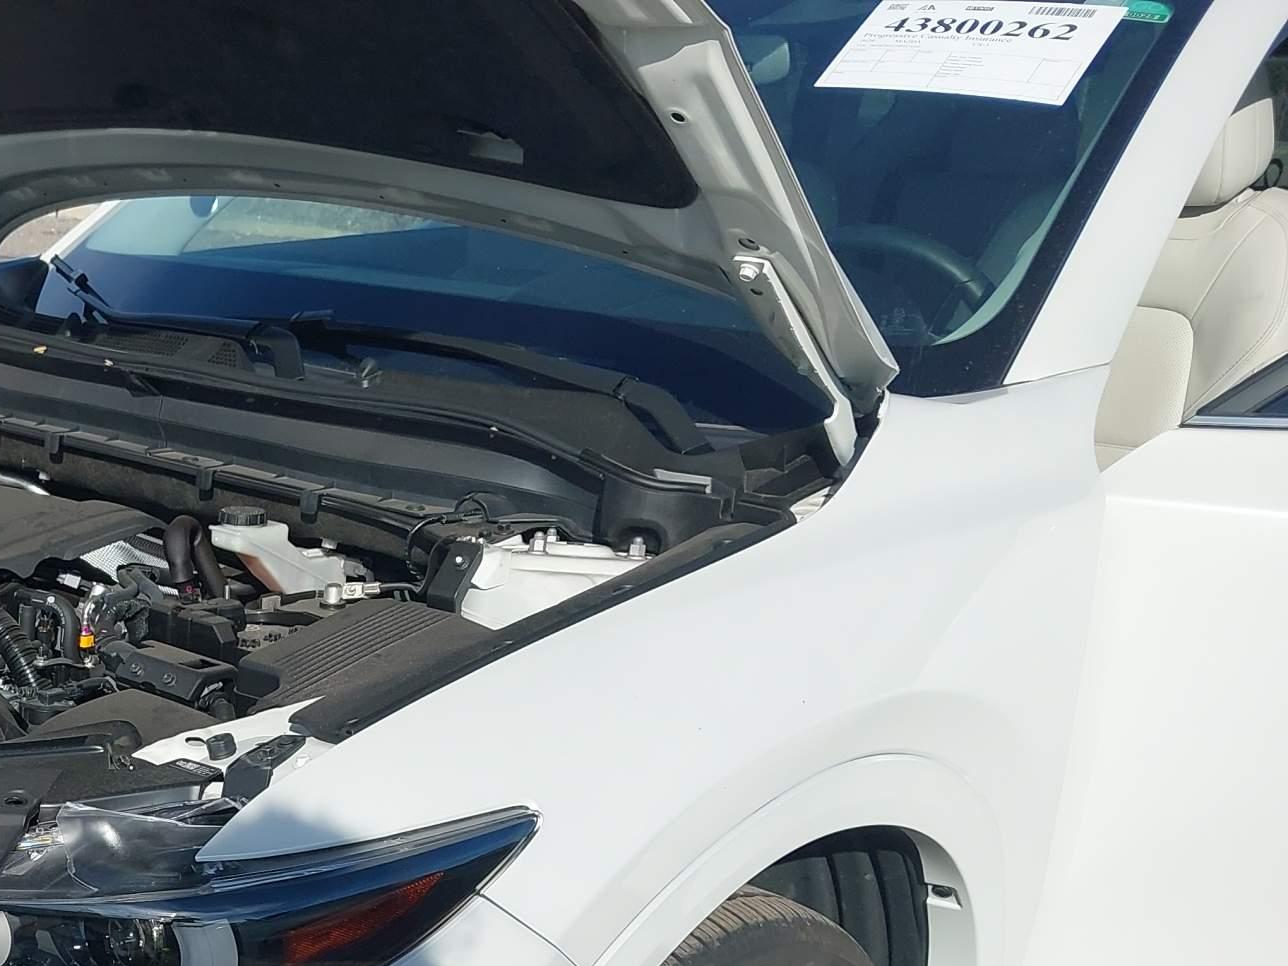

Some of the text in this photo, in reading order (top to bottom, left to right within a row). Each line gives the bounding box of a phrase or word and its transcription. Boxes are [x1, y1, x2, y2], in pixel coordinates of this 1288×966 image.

[864, 32, 1013, 43] Progressive Casualty Insurance
[884, 16, 1078, 41] 43800262
